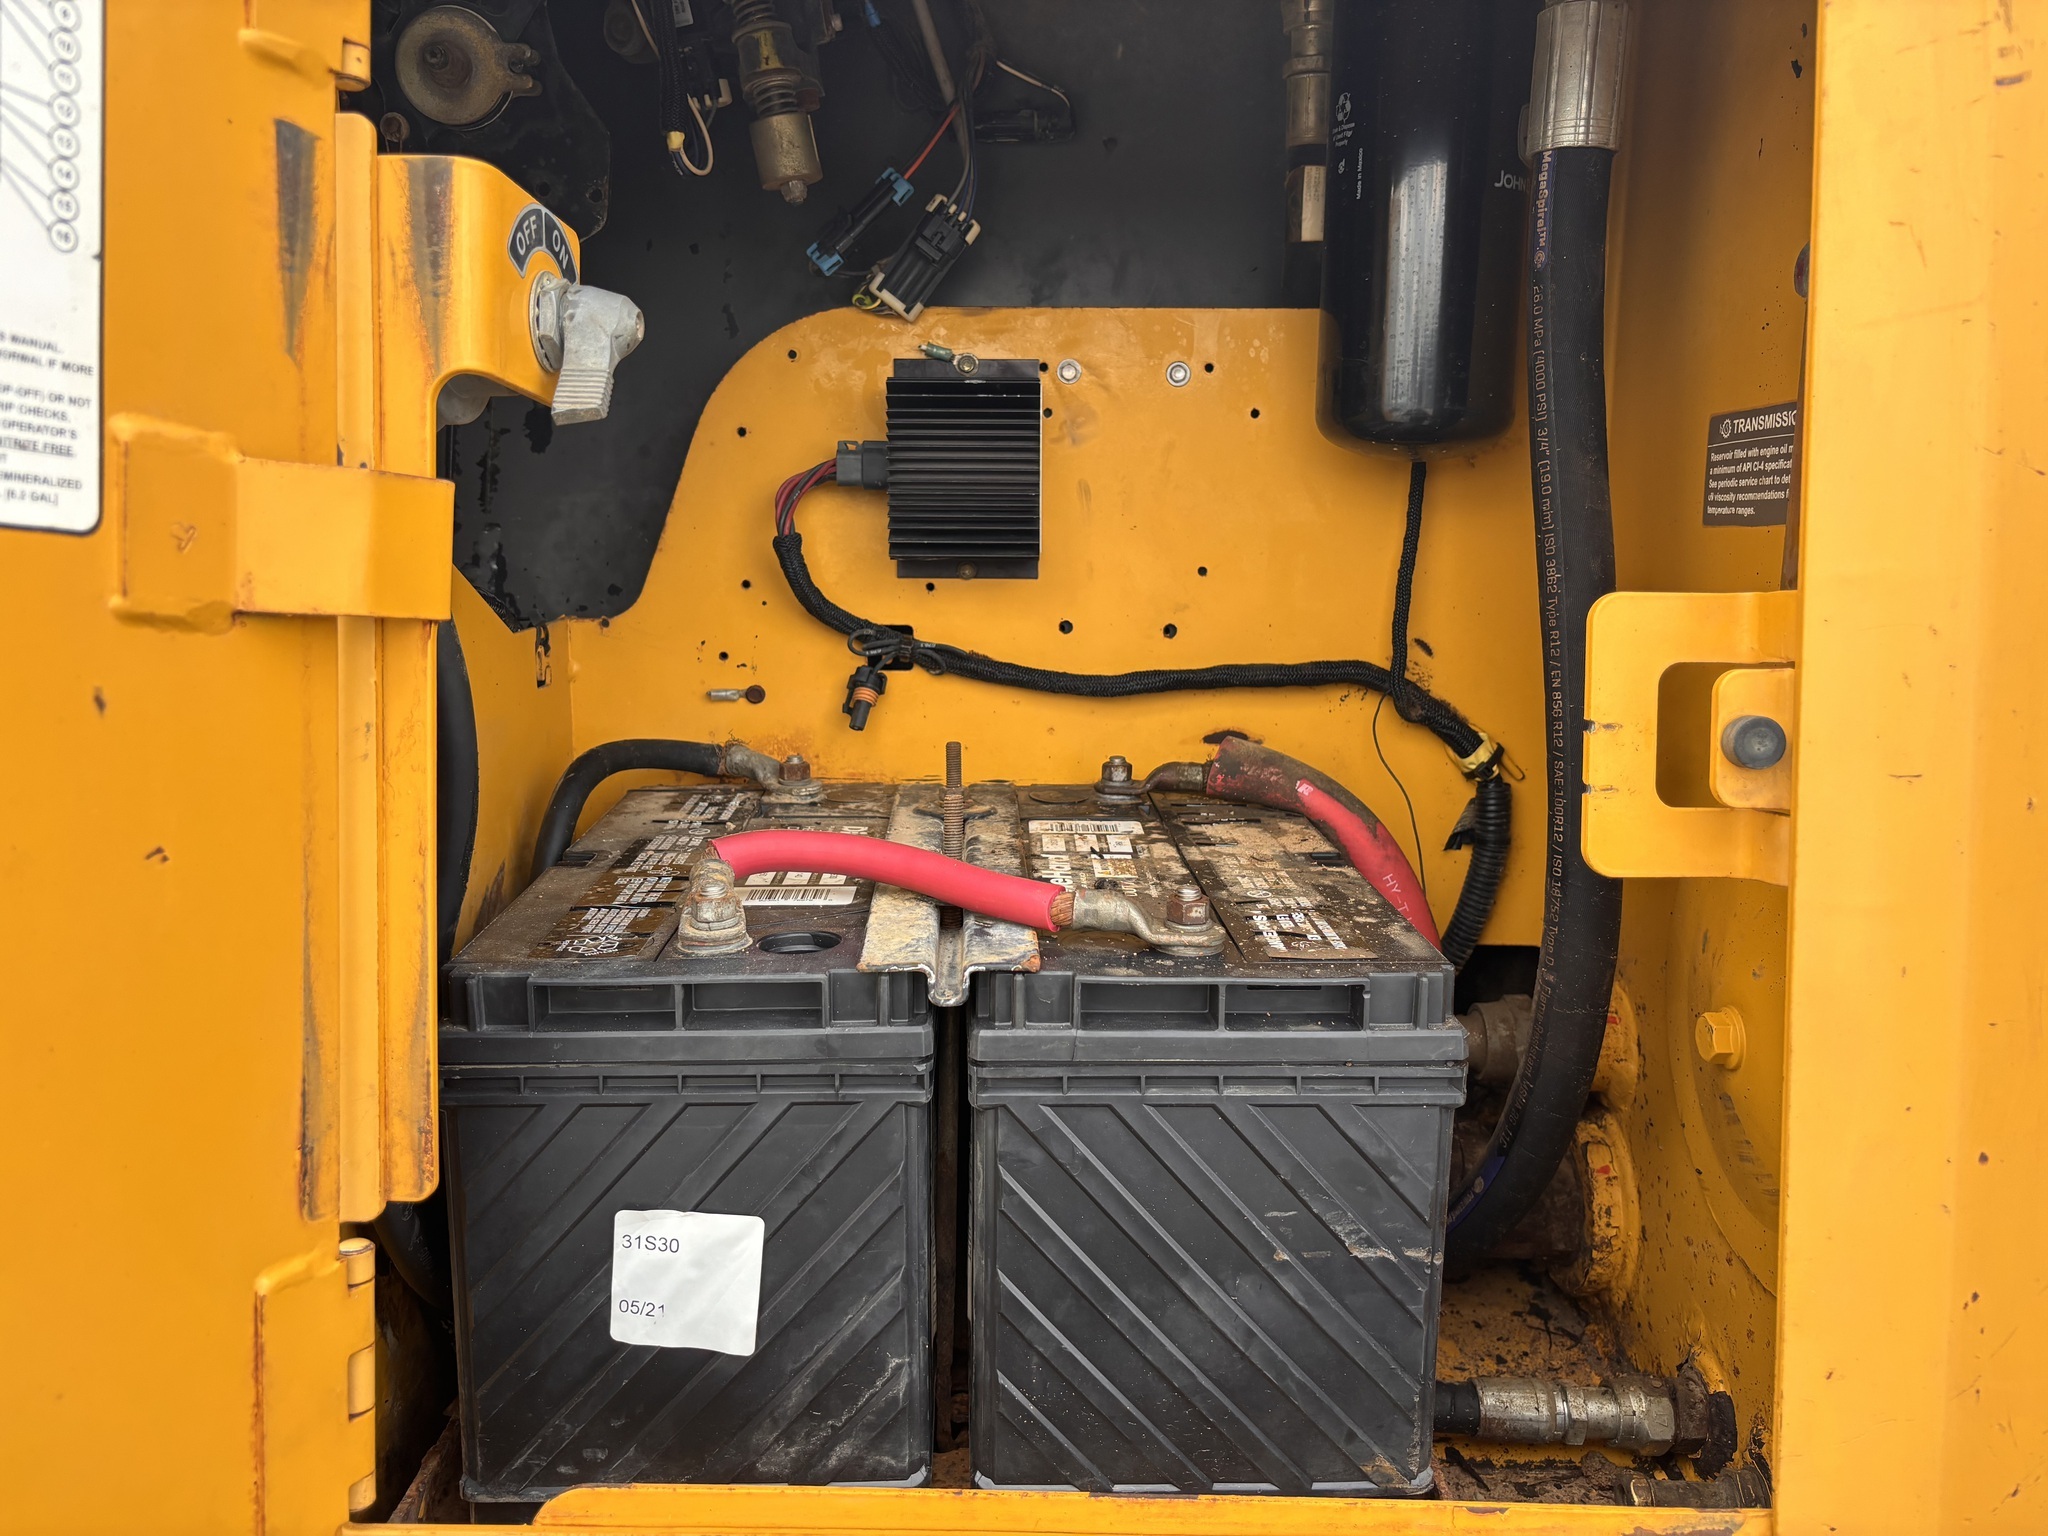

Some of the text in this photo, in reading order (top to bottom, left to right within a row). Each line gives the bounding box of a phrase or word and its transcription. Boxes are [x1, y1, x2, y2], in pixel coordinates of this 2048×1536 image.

[516, 215, 538, 256] OFF
[552, 229, 569, 270] ON
[1533, 285, 1544, 315] 28.0
[1533, 317, 1544, 348] MPa
[48, 358, 57, 368] IF
[61, 361, 94, 376] MORE
[48, 392, 65, 403] OR
[68, 396, 92, 408] NOT
[2, 419, 78, 440] OPERATOR'S
[43, 442, 75, 457] FREE
[1711, 449, 1734, 462] Reservoir
[1734, 447, 1747, 459] filled
[1747, 446, 1760, 458] with
[1760, 445, 1779, 458] engine
[1780, 443, 1788, 454] oil
[1713, 464, 1736, 475] minimum
[1736, 462, 1743, 473] of
[1742, 461, 1753, 473] API
[1708, 478, 1718, 489] See
[1717, 477, 1739, 491] periodic
[1739, 476, 1758, 487] service
[1758, 474, 1774, 486] chart
[1774, 474, 1781, 485] to
[1714, 491, 1737, 504] viscosity
[1736, 488, 1785, 501] recommendations
[1706, 505, 1756, 518] temperature ranges.
[1544, 533, 1556, 556] ISO
[1545, 559, 1558, 594] 3862
[1545, 596, 1559, 628] Type
[1550, 630, 1561, 658] R12
[1550, 670, 1562, 688] EN
[1552, 720, 1564, 748] R12
[1551, 855, 1563, 877] ISO
[1549, 879, 1562, 923] 18752
[621, 1234, 681, 1254] 31S30
[618, 1299, 666, 1318] 05/21
